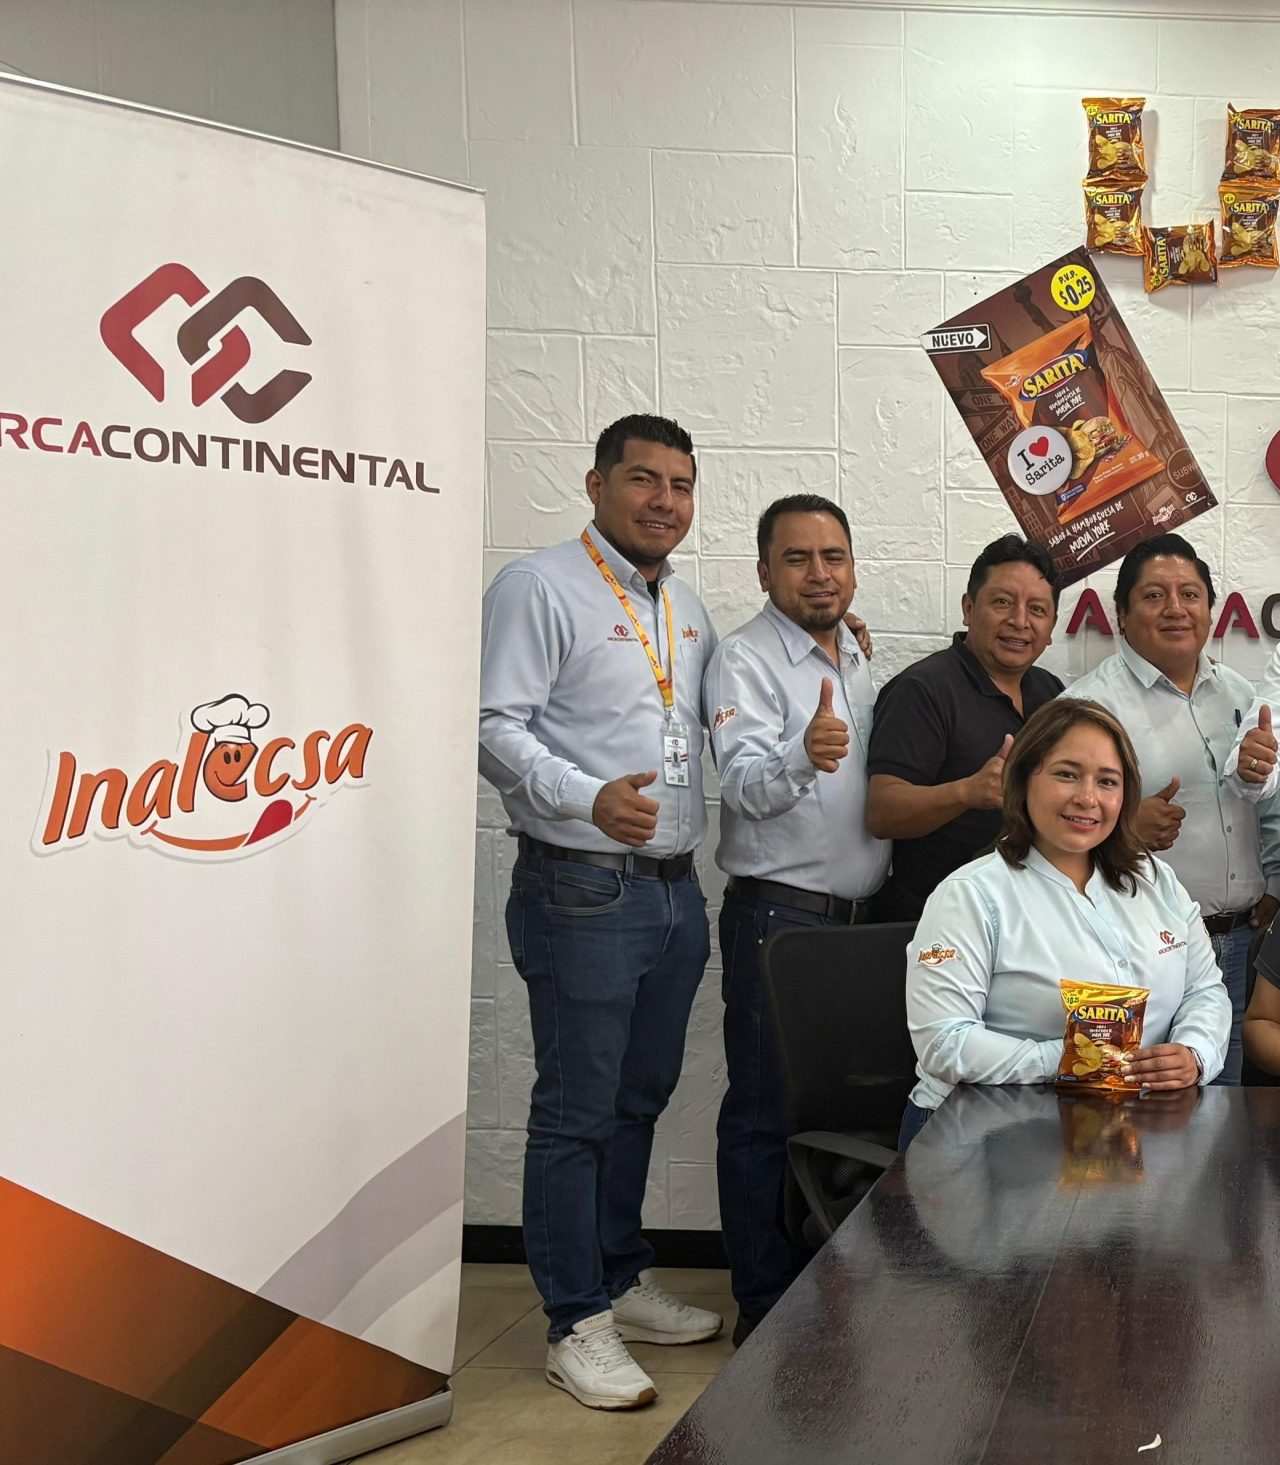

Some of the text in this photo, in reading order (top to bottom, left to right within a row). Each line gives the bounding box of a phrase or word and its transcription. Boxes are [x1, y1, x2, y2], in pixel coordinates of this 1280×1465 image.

[1096, 113, 1131, 124] SARITA
[1238, 119, 1271, 131] SARITA
[1096, 194, 1131, 205] SARITA
[1234, 202, 1268, 214] SARITA
[1158, 237, 1169, 275] SARITA
[1058, 270, 1078, 284] P.V.P.
[1059, 275, 1093, 306] $0,25
[932, 333, 974, 348] NUEVO
[1023, 354, 1087, 398] SARITA
[0, 412, 441, 494] RCACONTINENTAL
[1017, 448, 1035, 471] I
[1025, 452, 1066, 486] Sarita
[1048, 533, 1066, 548] SABOR
[1071, 503, 1116, 533] HAMBURGUESA
[1113, 500, 1124, 513] DE
[1068, 519, 1111, 553] NUEVA YORK
[1056, 550, 1095, 571] UBWAY
[42, 723, 374, 845] Inalecsa
[1078, 1005, 1127, 1023] SARITA
